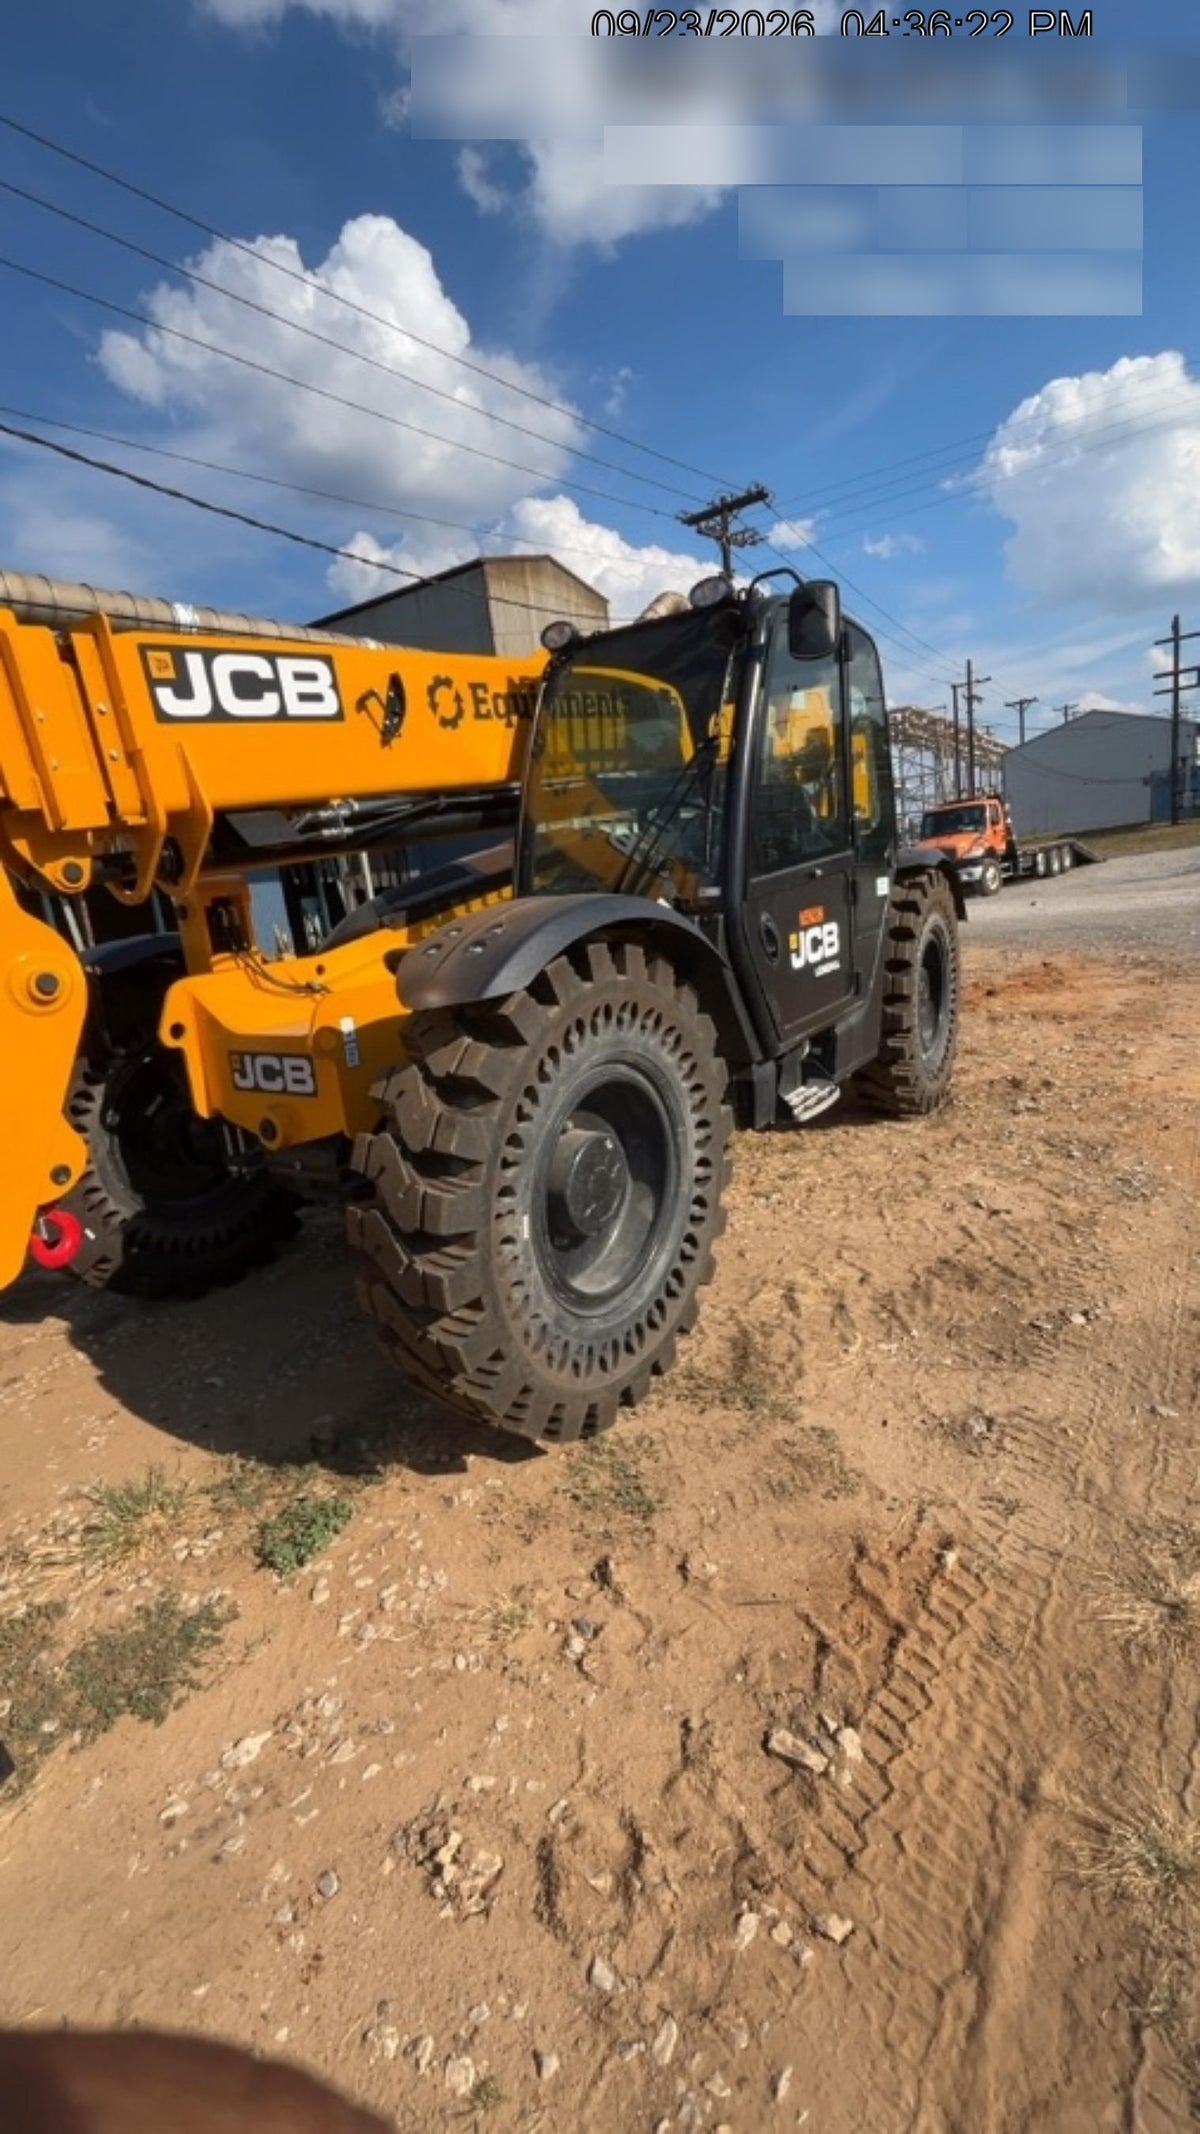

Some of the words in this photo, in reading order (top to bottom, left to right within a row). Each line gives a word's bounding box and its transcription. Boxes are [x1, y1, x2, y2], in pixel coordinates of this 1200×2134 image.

[154, 651, 341, 717] JCB
[789, 920, 840, 970] JCB
[233, 1053, 315, 1095] JCB
